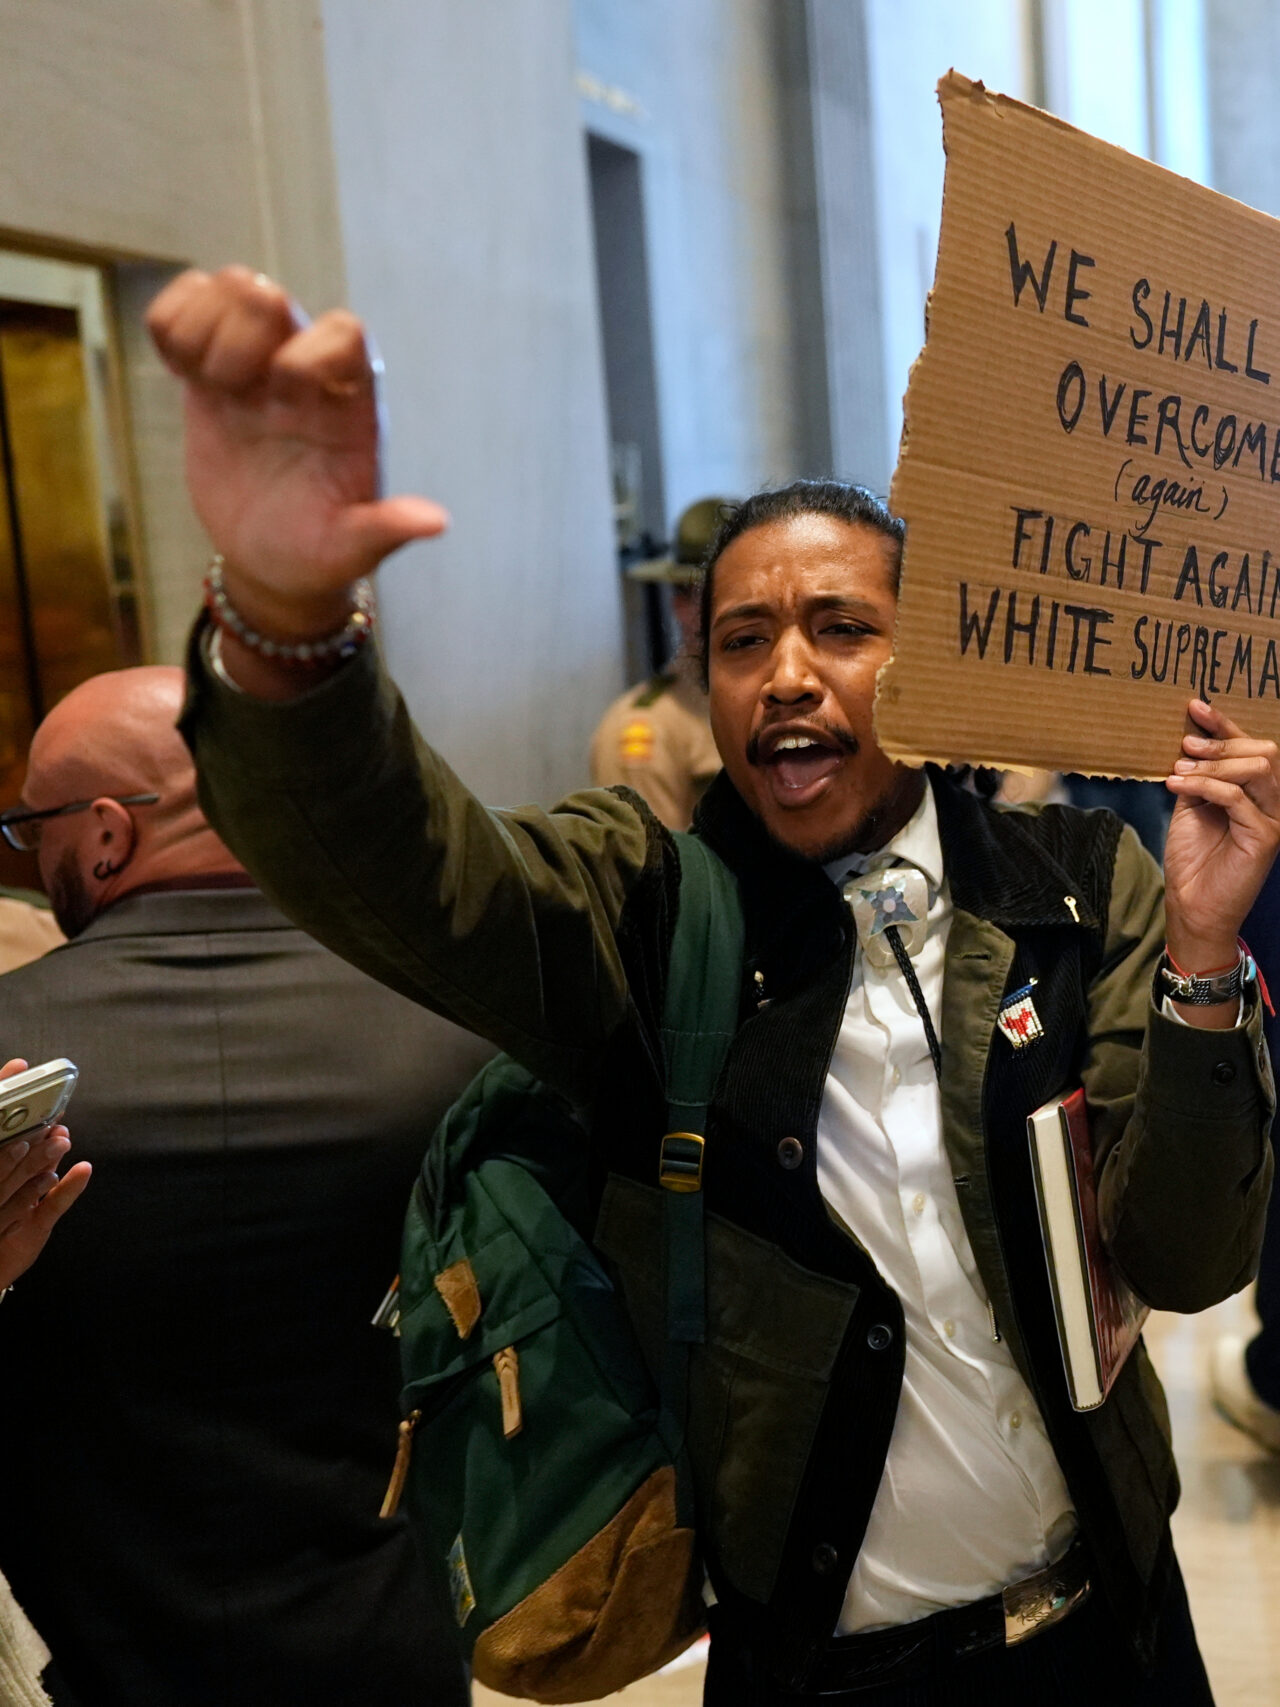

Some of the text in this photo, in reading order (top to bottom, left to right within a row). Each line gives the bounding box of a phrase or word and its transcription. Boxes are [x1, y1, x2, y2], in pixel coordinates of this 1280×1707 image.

[1004, 221, 1272, 385] WE SHALL
[1114, 458, 1229, 538] (again)
[1009, 505, 1164, 595] FIGHT
[958, 581, 1115, 677] WHITE
